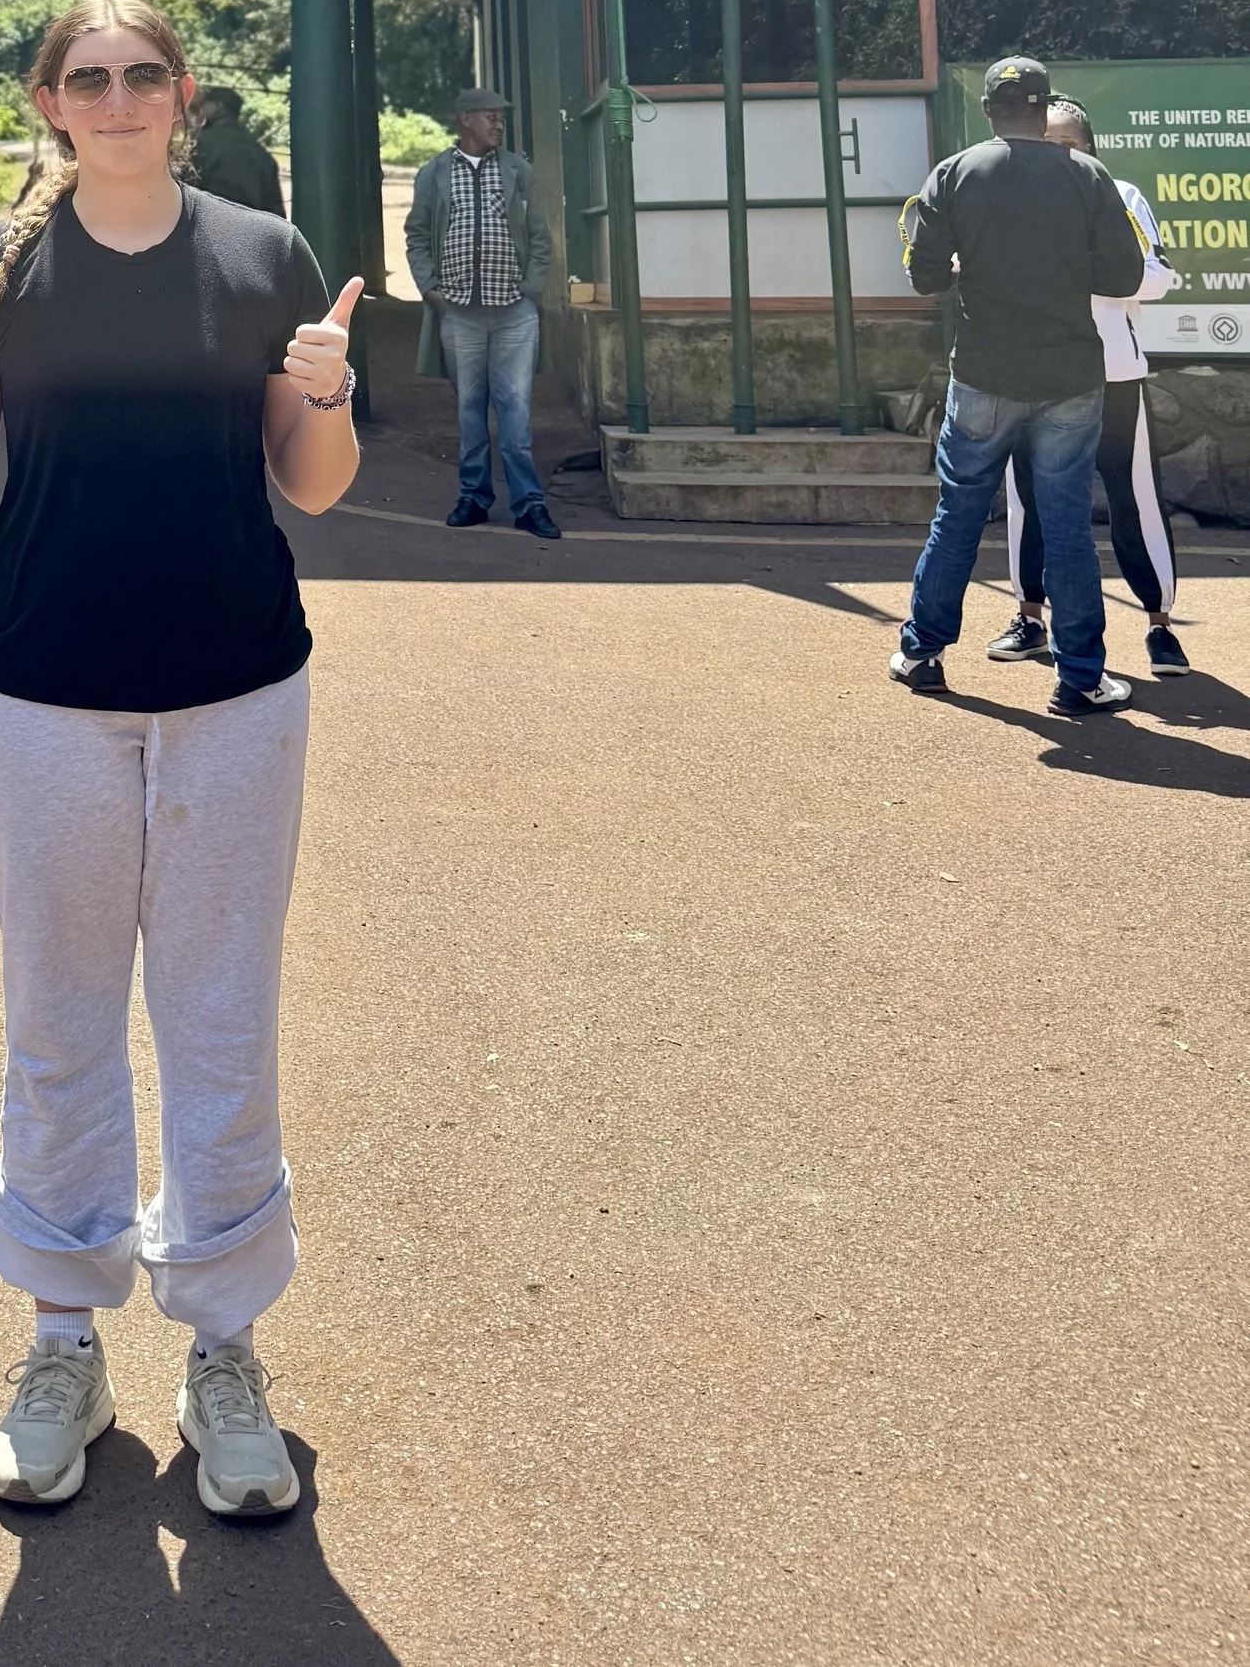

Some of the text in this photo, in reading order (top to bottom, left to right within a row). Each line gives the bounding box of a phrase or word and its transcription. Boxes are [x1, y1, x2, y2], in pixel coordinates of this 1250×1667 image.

[1128, 110, 1160, 126] THE
[1164, 109, 1222, 125] UNITED
[1093, 133, 1154, 149] INISTRY
[1158, 133, 1180, 148] OF
